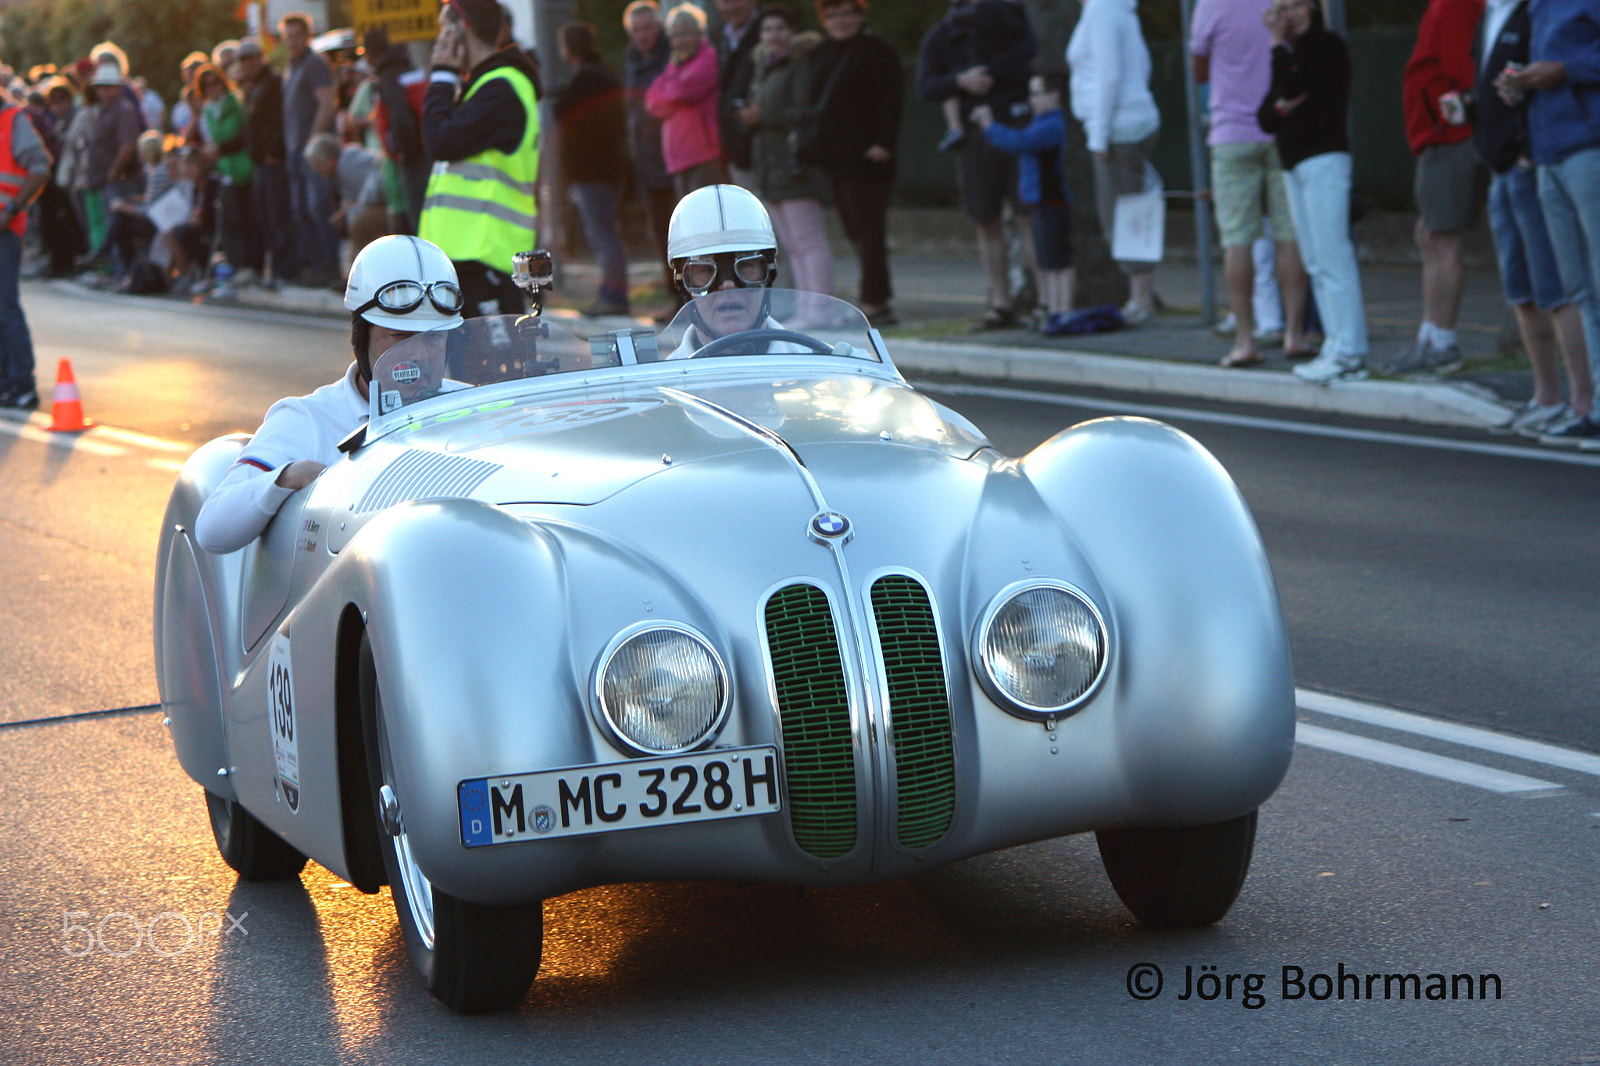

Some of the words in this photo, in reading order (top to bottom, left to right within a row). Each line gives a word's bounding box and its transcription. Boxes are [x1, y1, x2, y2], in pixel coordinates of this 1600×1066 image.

[494, 406, 631, 430] 139
[270, 661, 293, 743] 139
[490, 783, 526, 835] M
[558, 773, 627, 827] MC
[471, 819, 482, 834] D
